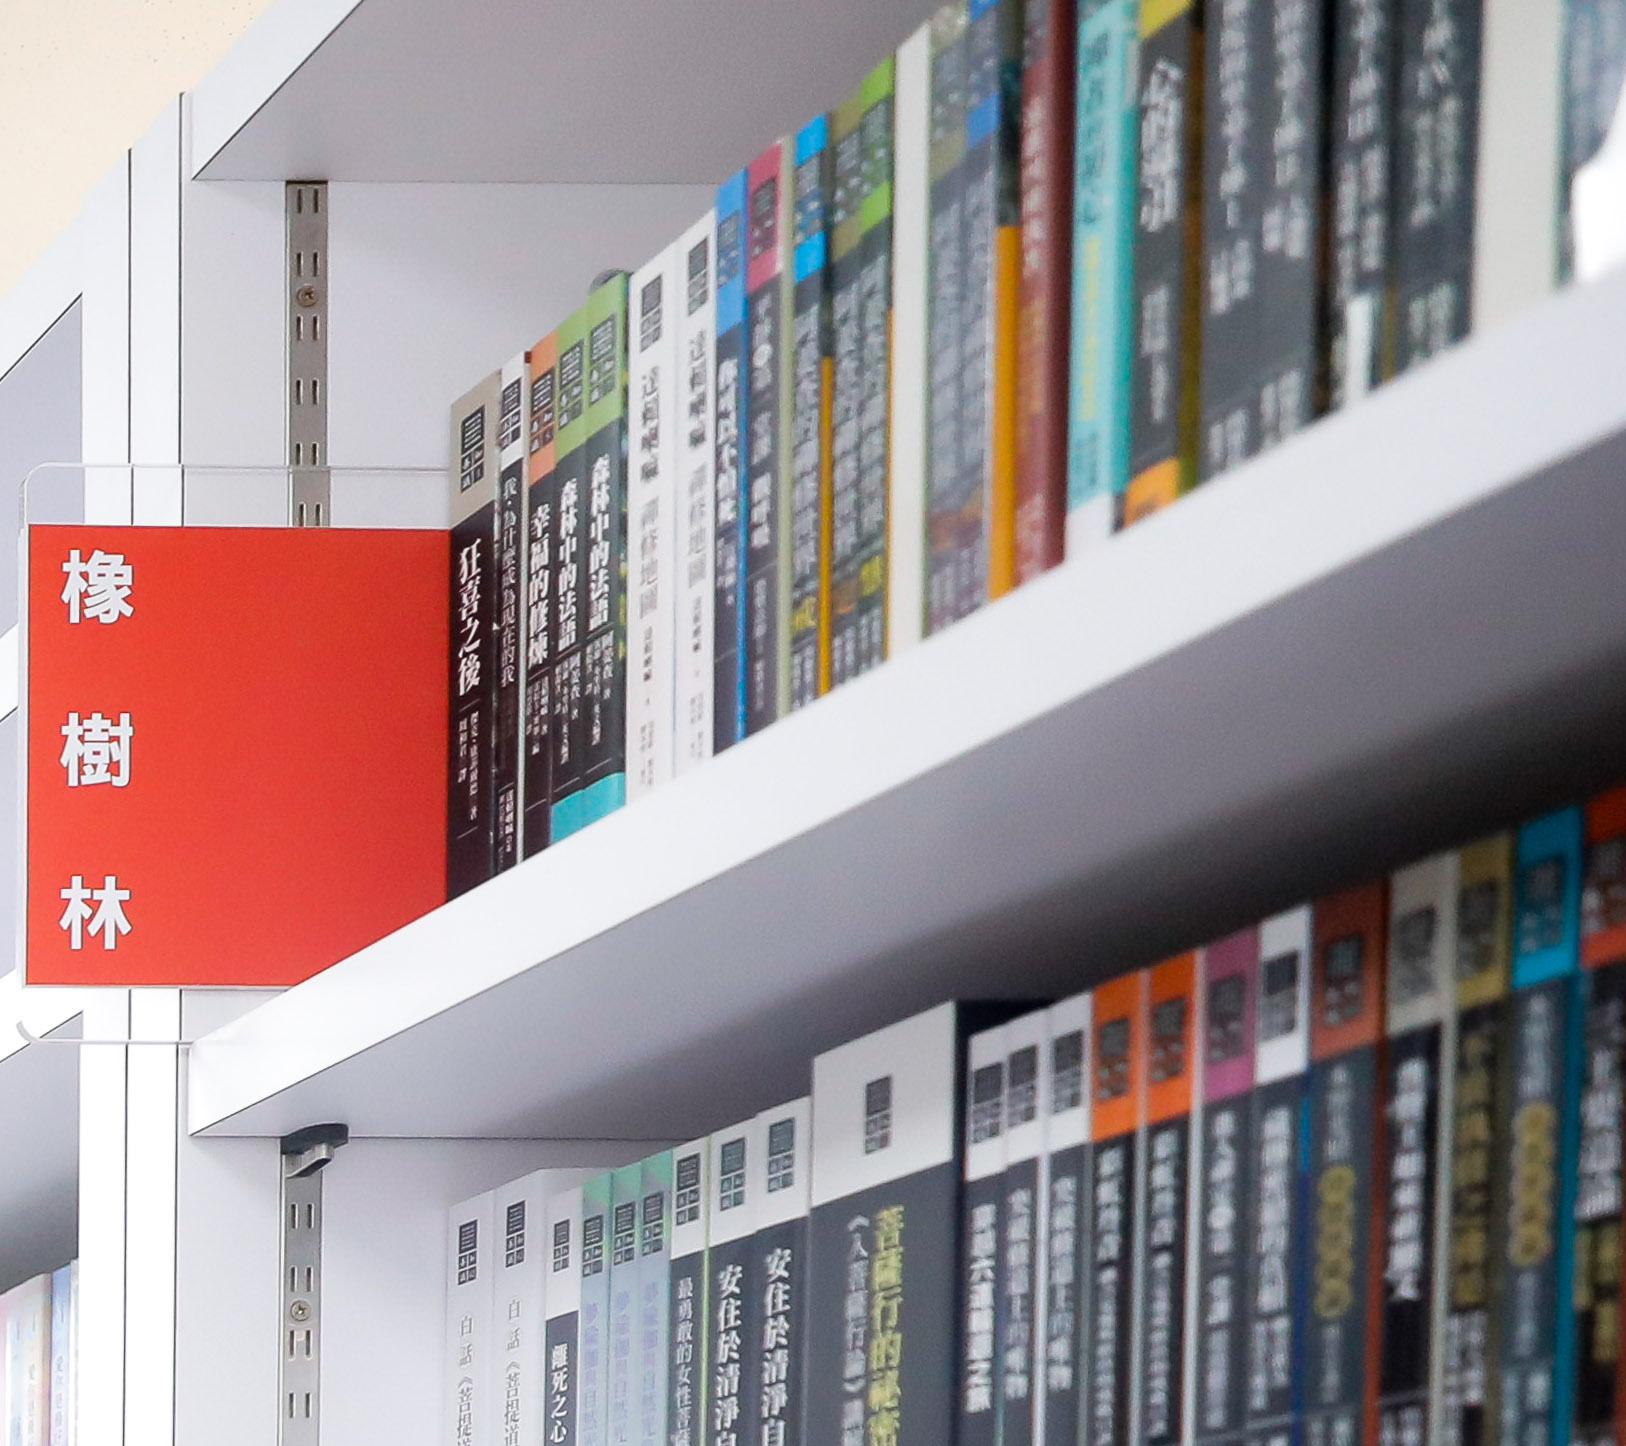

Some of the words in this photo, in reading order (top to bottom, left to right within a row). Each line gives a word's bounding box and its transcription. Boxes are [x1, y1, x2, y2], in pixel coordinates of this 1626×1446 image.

[457, 537, 482, 698] 狂喜之後
[557, 477, 579, 657] 森林中的法語
[588, 453, 612, 633] 森林中的法語
[60, 549, 134, 951] 橡樹林
